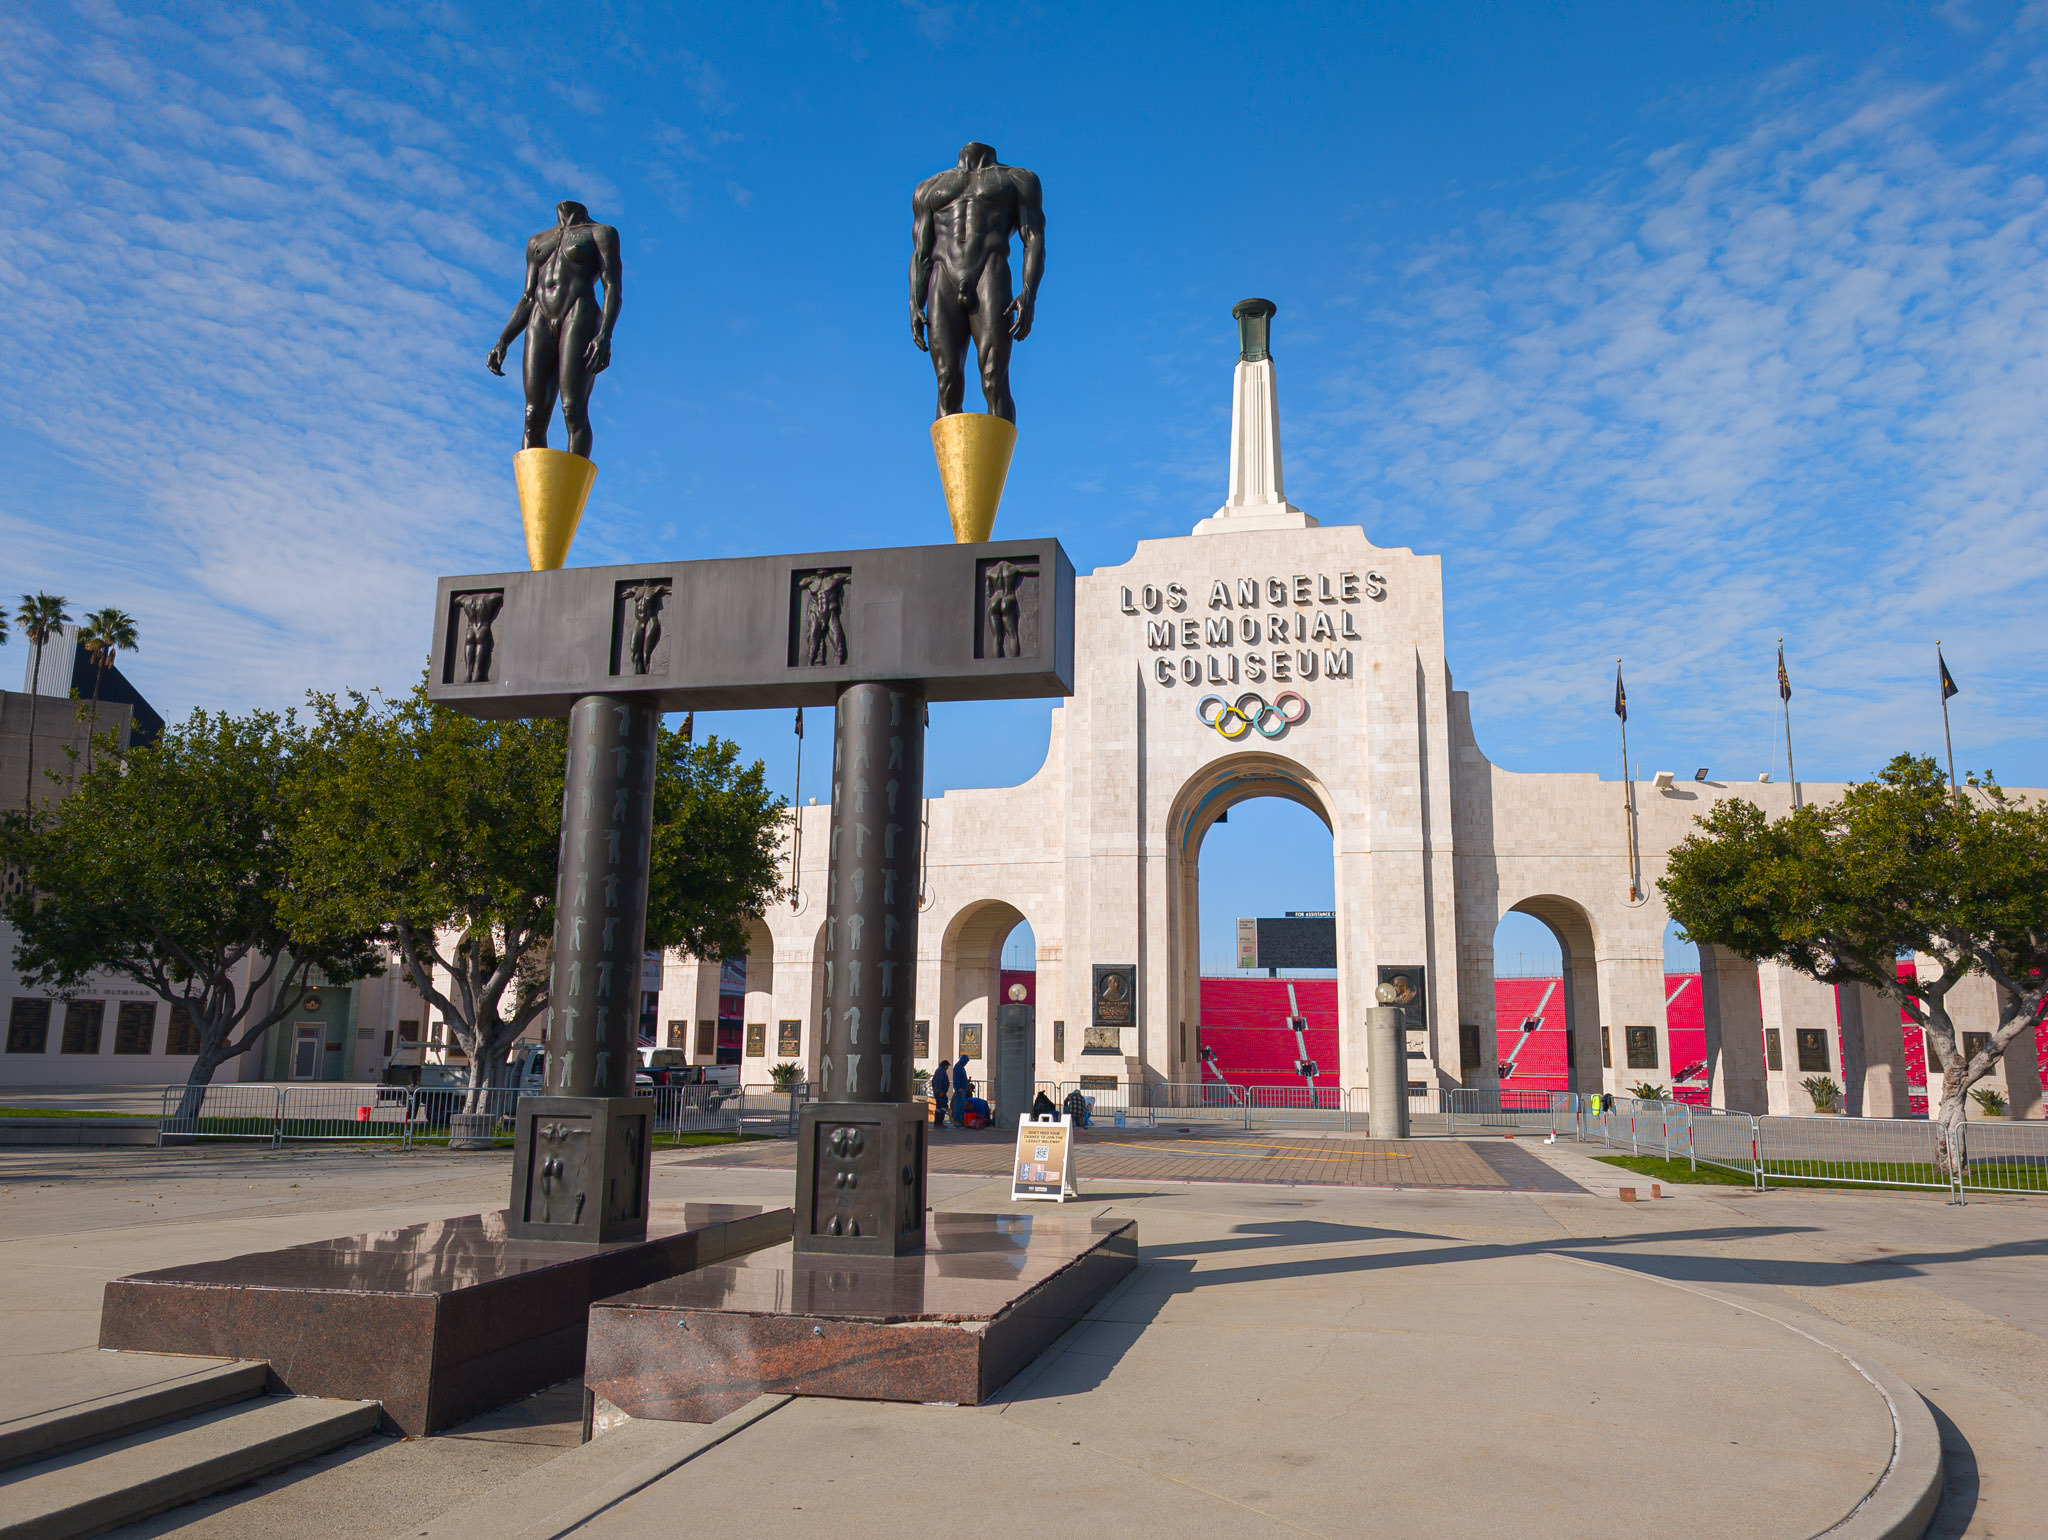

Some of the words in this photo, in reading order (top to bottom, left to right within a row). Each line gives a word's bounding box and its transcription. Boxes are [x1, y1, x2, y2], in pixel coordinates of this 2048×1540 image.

[1120, 582, 1187, 613] LOS
[1208, 570, 1384, 609] ANGELES
[1147, 609, 1358, 647] MEMORIAL
[1154, 648, 1351, 684] COLISEUM
